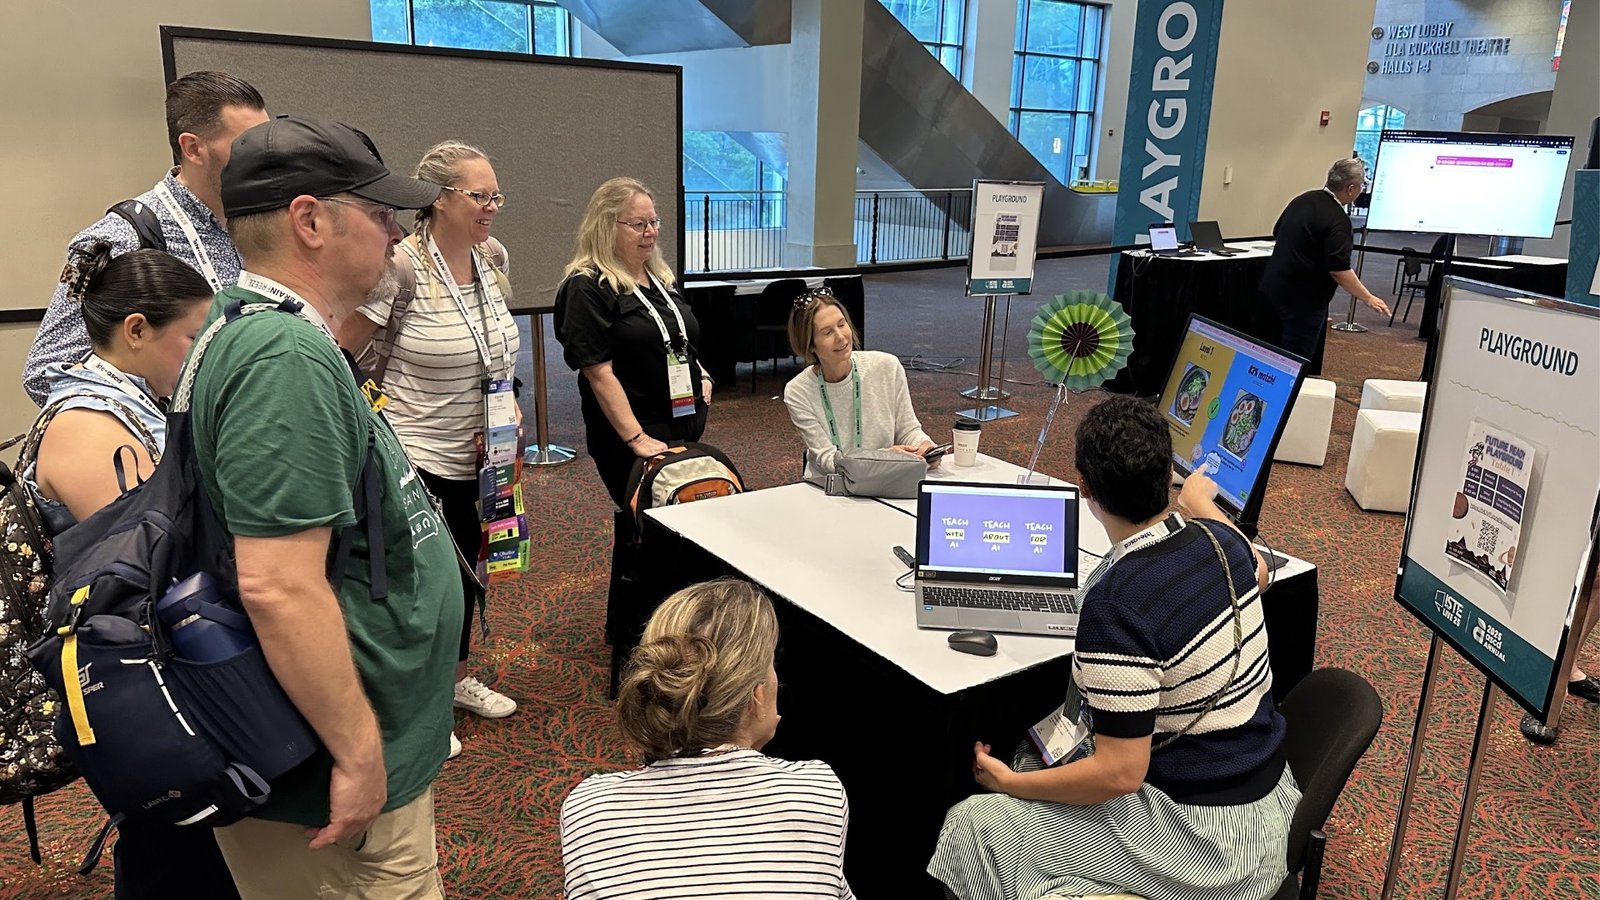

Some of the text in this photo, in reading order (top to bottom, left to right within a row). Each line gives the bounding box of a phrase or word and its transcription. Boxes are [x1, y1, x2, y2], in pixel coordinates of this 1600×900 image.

[1387, 22, 1453, 39] WEST LOBBY
[1384, 42, 1406, 57] LILA
[1462, 37, 1511, 56] THEATRE
[1381, 60, 1413, 75] HALLS
[991, 194, 1028, 204] PLAYGROUND
[1479, 327, 1579, 377] PLAYGROUND
[1485, 434, 1526, 460] FUTURE READY
[1485, 446, 1524, 471] PLAYGROUND
[1491, 459, 1511, 474] Table
[941, 517, 969, 527] TEACH
[982, 520, 1011, 530] TEACH
[1024, 522, 1053, 532] TEACH
[945, 530, 964, 539] WITH
[983, 533, 1010, 542] ABOUT
[1030, 535, 1047, 544] FOR
[1123, 530, 1156, 549] iste+ascd
[949, 541, 959, 549] AI
[991, 544, 1001, 552] AI
[1033, 546, 1043, 554] AI
[1444, 593, 1465, 618] ISTE
[1442, 607, 1462, 628] LIVE 25
[1486, 624, 1503, 640] 2025
[1485, 633, 1503, 648] ascd
[1482, 641, 1507, 662] ANNUAL
